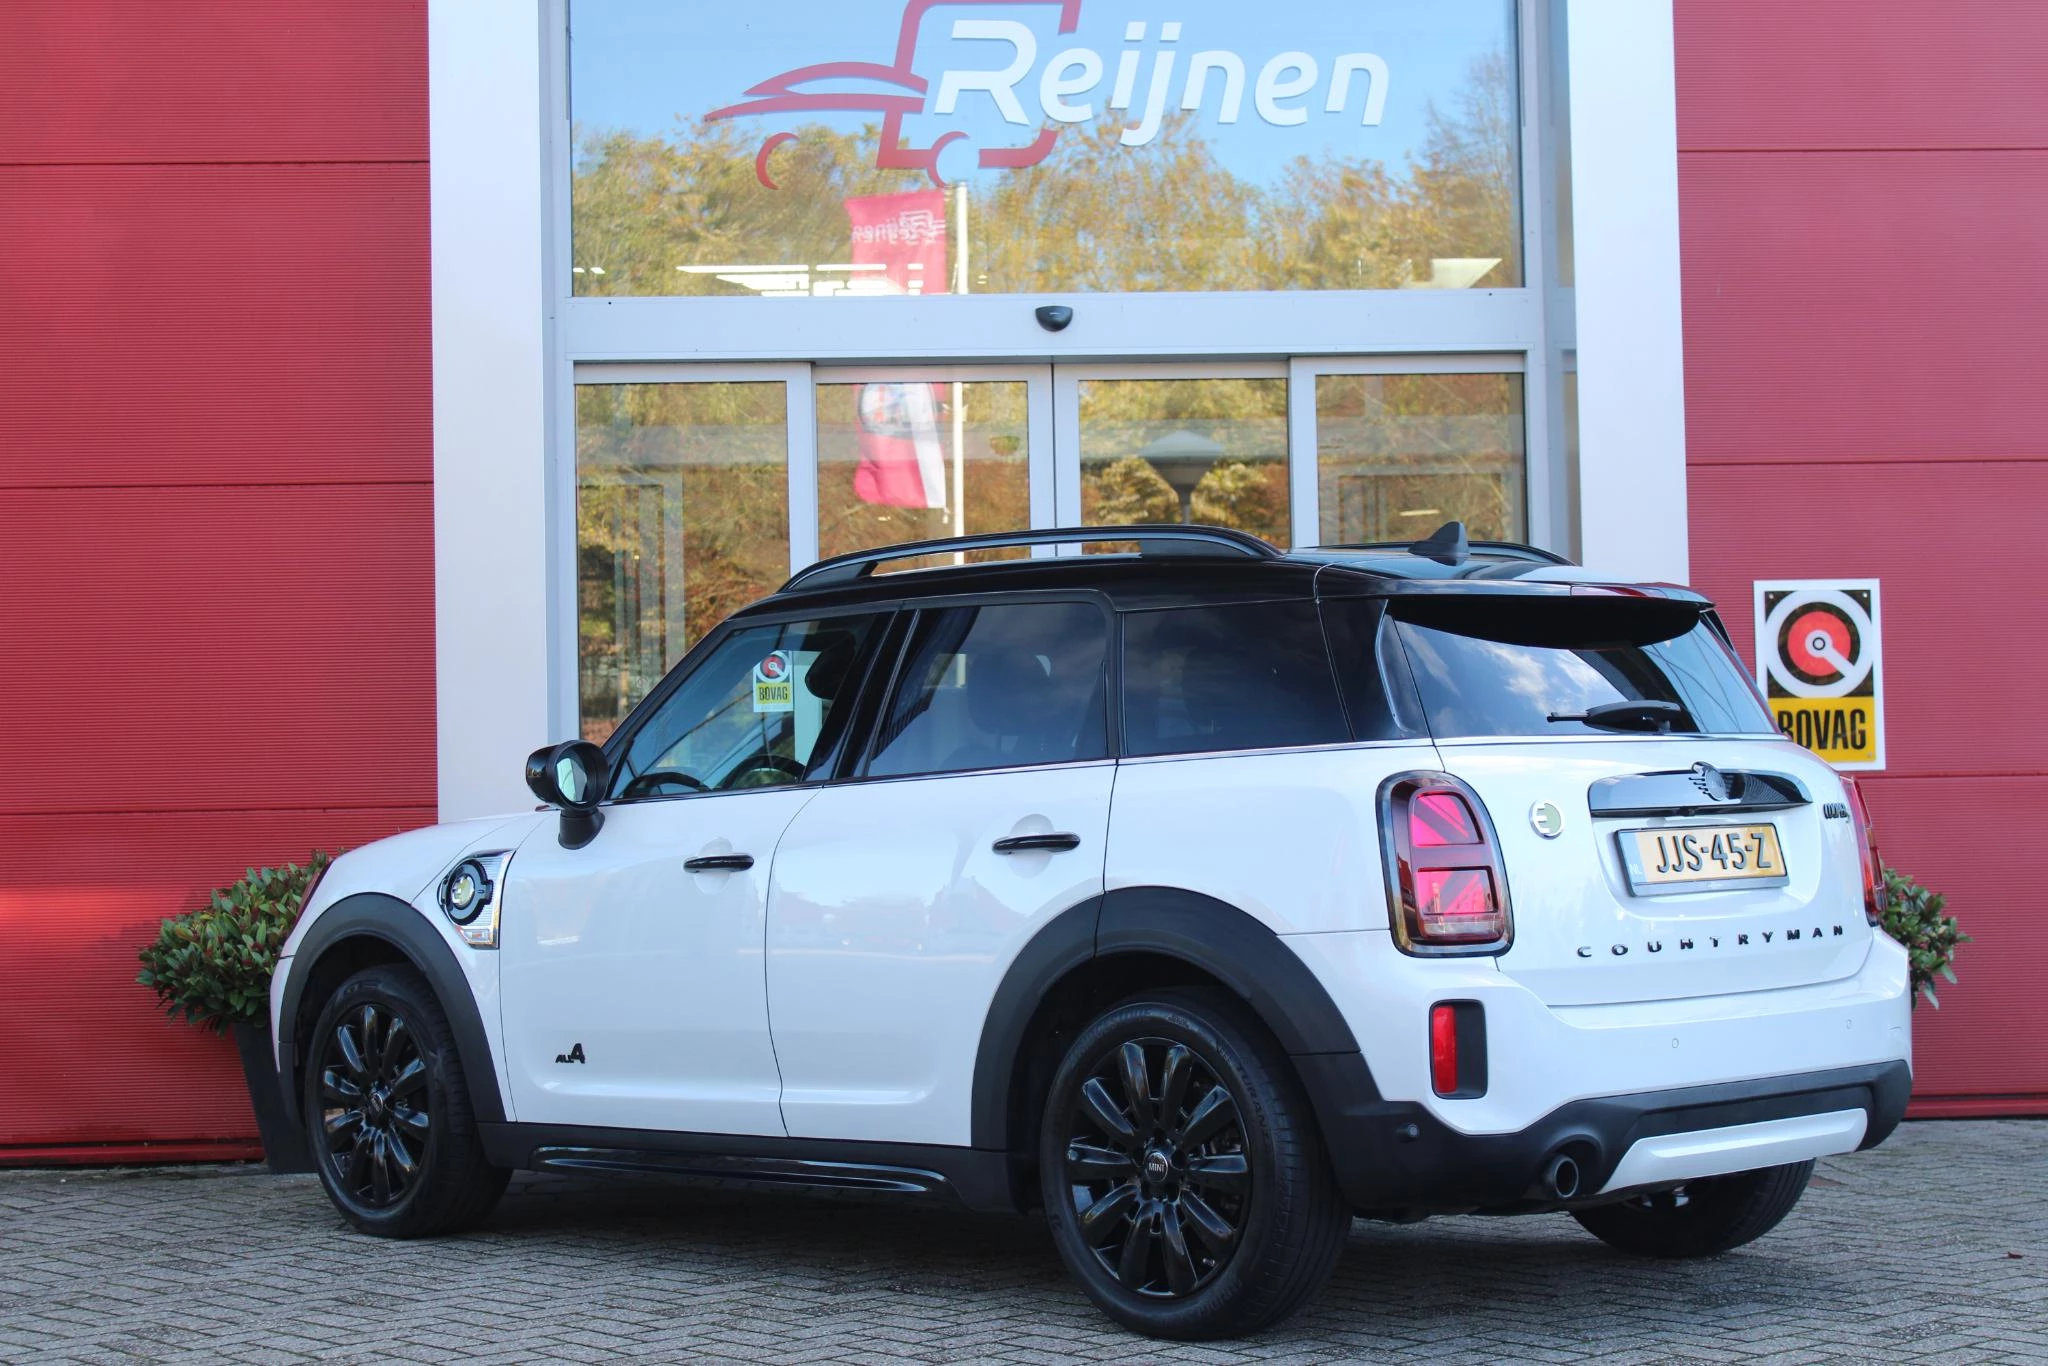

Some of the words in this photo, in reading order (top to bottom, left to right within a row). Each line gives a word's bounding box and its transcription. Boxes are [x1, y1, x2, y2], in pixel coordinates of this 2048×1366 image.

[933, 20, 1390, 147] Reijnen
[759, 686, 788, 701] BOVAG
[1777, 708, 1867, 750] BOVAG
[1656, 832, 1772, 874] JJS-45-Z
[1576, 925, 1844, 958] COUNTRYMAN
[1148, 1162, 1165, 1173] MINI
